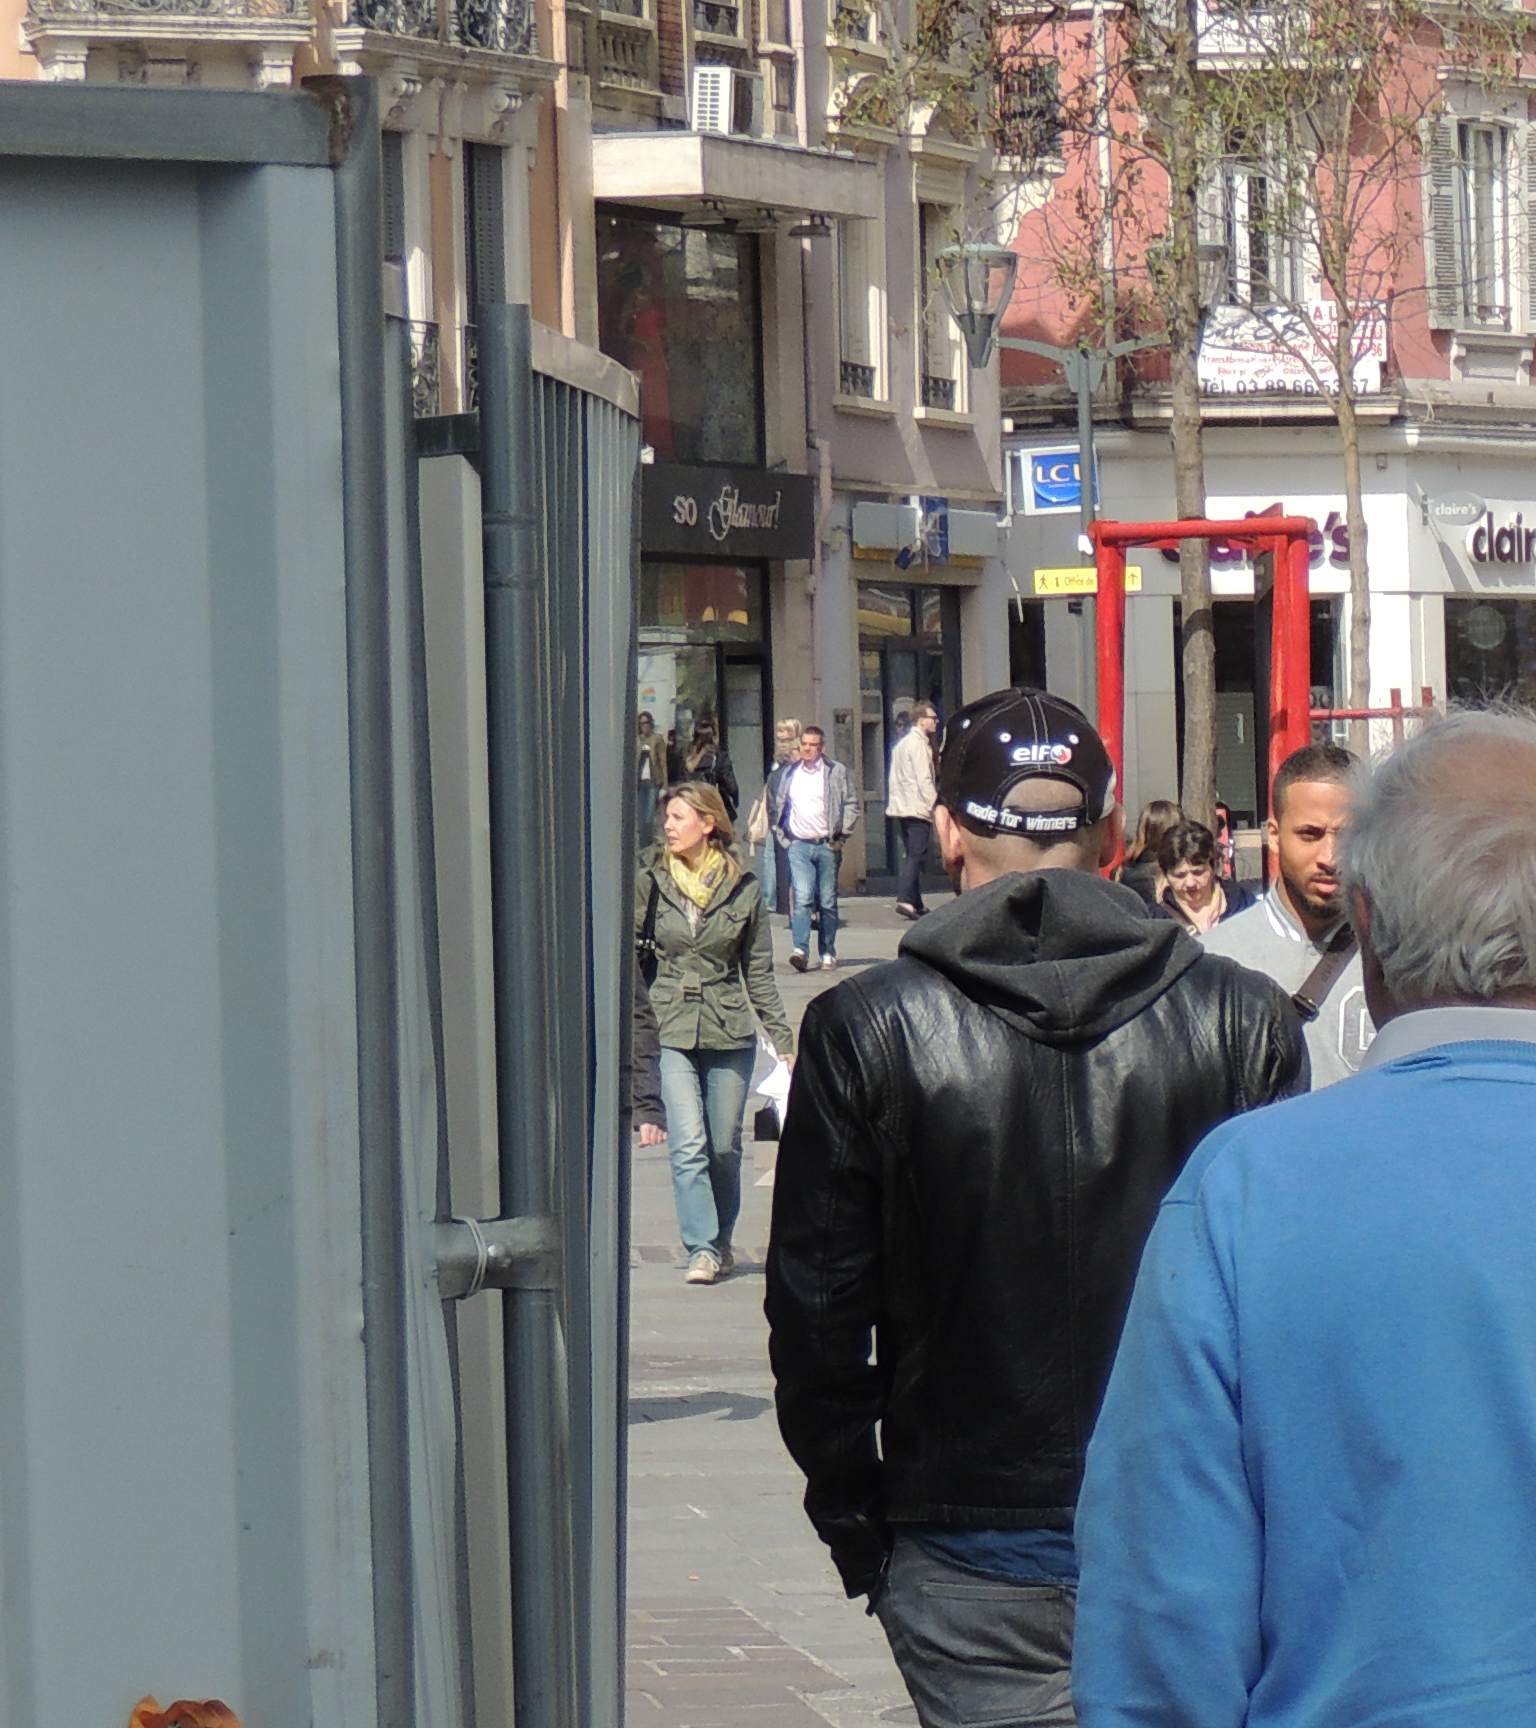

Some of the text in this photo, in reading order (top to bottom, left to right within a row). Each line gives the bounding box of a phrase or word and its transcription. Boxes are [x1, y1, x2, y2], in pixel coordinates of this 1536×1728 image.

[1435, 502, 1478, 516] claire's
[1064, 574, 1085, 587] Office
[966, 801, 1077, 831] made for winners
